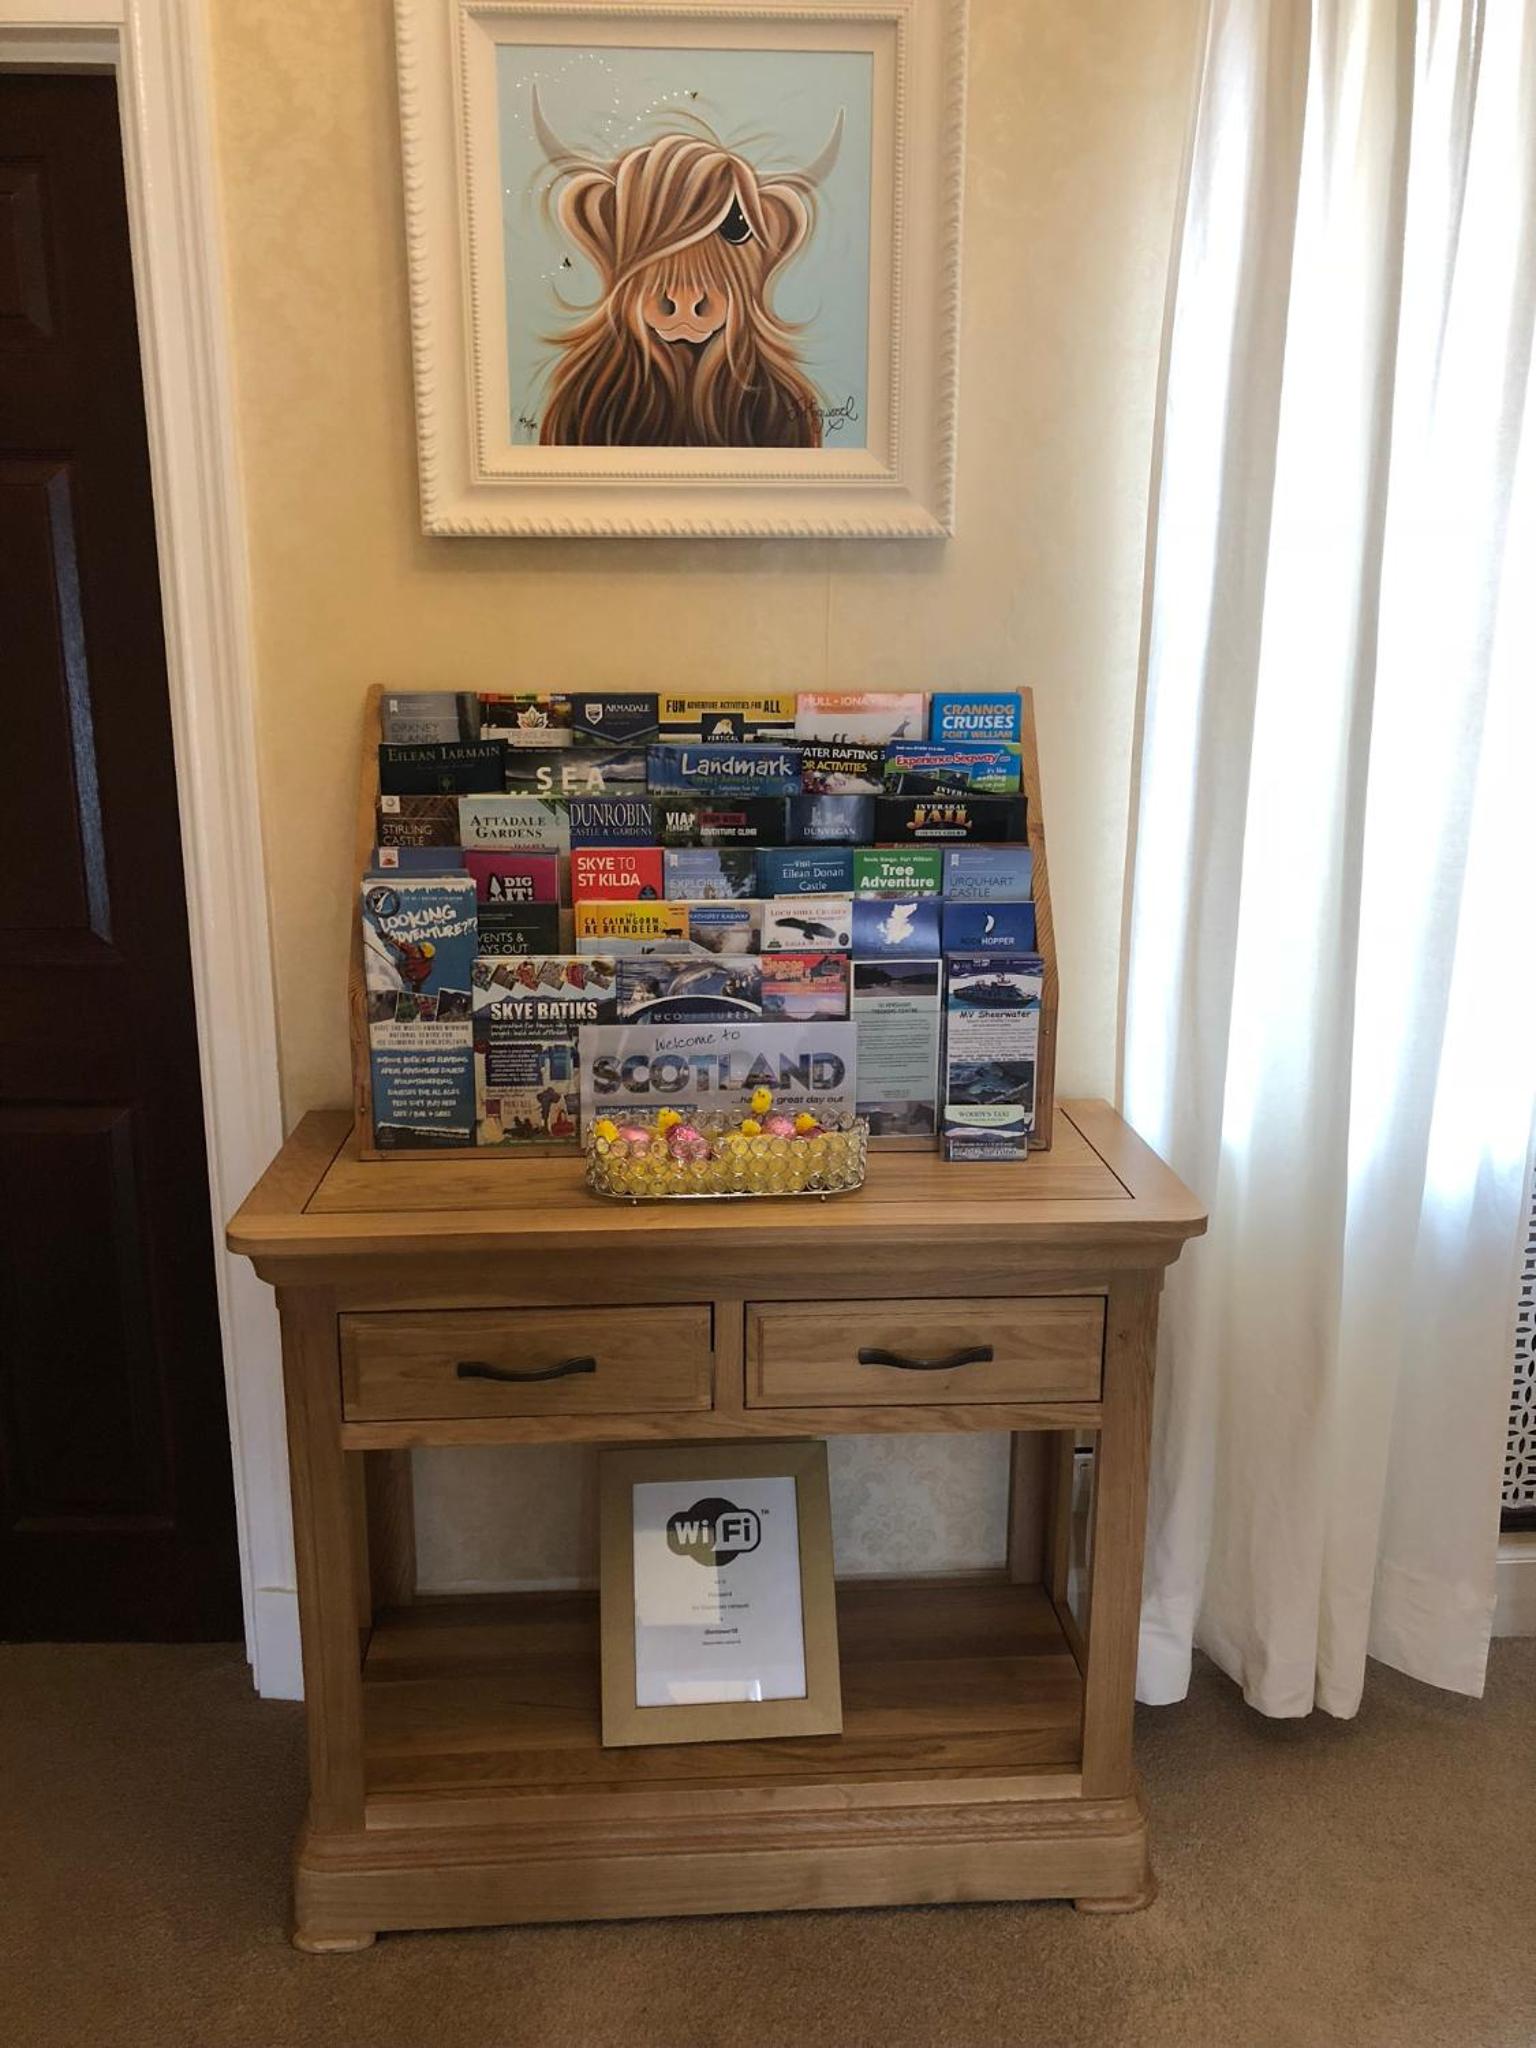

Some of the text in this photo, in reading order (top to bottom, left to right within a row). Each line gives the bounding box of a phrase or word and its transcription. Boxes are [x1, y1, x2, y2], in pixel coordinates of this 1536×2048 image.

[604, 702, 651, 713] ARMADALE
[665, 700, 686, 713] FUN
[763, 700, 781, 713] ALL
[942, 704, 1014, 715] CRANNOG
[942, 716, 1014, 730] CRUISES
[942, 731, 1013, 739] FORT WILLIAM
[800, 747, 878, 761] ATER RAFTING
[681, 752, 794, 777] Landmark
[818, 760, 868, 773] ACTIVITIES
[536, 766, 607, 791] SEA
[470, 814, 547, 827] ATTADALE
[569, 803, 652, 828] DUNROBIN
[906, 809, 974, 829] JAIL
[382, 824, 433, 835] STIRLING
[475, 826, 543, 839] GARDENS
[803, 826, 857, 836] DUNVEGAN
[383, 836, 425, 847] CASTLE
[577, 857, 636, 871] SKYE TO
[880, 863, 915, 876] Tree
[813, 867, 845, 878] Donan
[504, 877, 533, 887] DIG
[577, 873, 641, 888] ST KILDA
[860, 875, 935, 888] Adventure
[377, 903, 457, 933] LOOKING
[602, 916, 660, 925] CAIRNGORM
[602, 925, 660, 934] REINDEER
[477, 933, 514, 943] VENTS
[477, 943, 529, 954] AYS OUT
[490, 1001, 599, 1021] SKYE BATIKS
[655, 1029, 741, 1051] Welcome to
[592, 1051, 846, 1094] SCOTLAND
[776, 1095, 806, 1106] great
[807, 1096, 825, 1106] day
[826, 1095, 845, 1104] out
